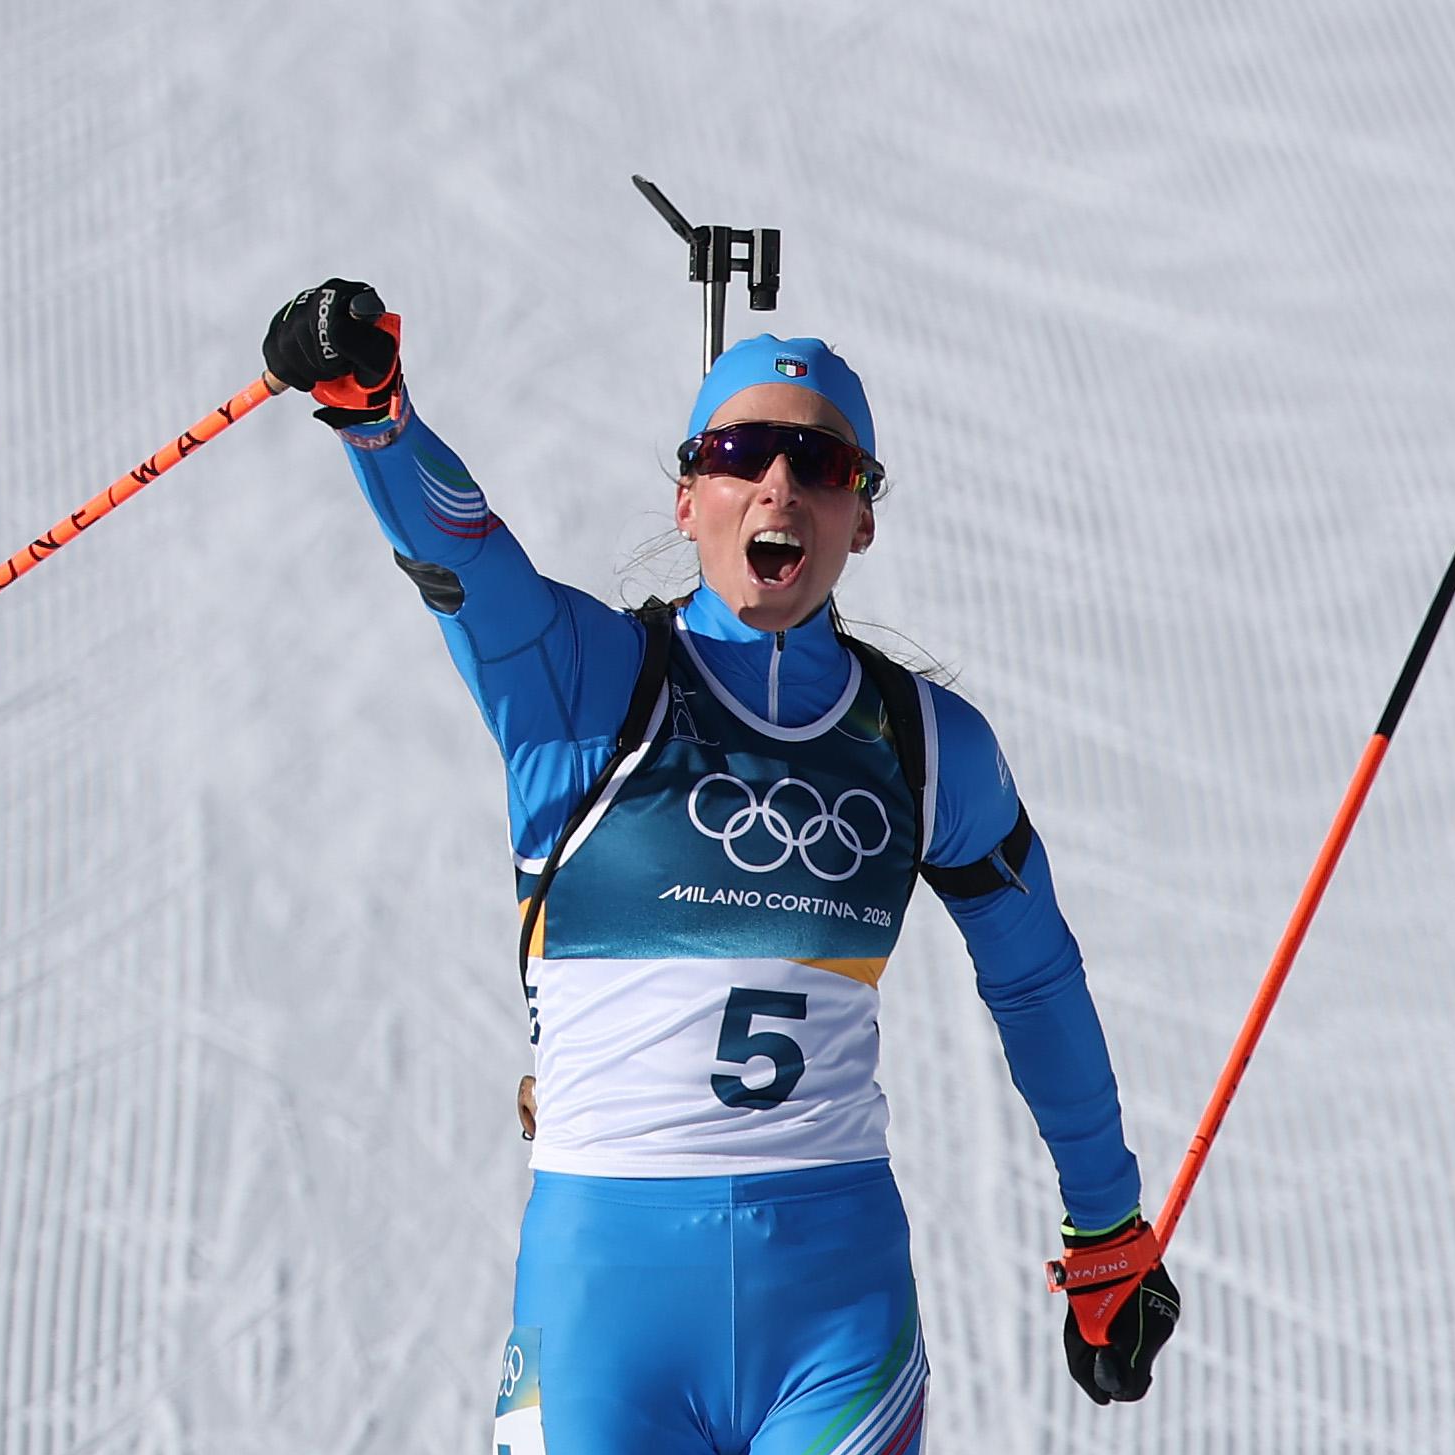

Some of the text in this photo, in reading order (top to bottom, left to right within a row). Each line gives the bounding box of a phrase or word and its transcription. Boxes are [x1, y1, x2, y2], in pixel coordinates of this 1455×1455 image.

[658, 884, 893, 928] MILANO CORTINA 2026
[710, 986, 809, 1111] 5
